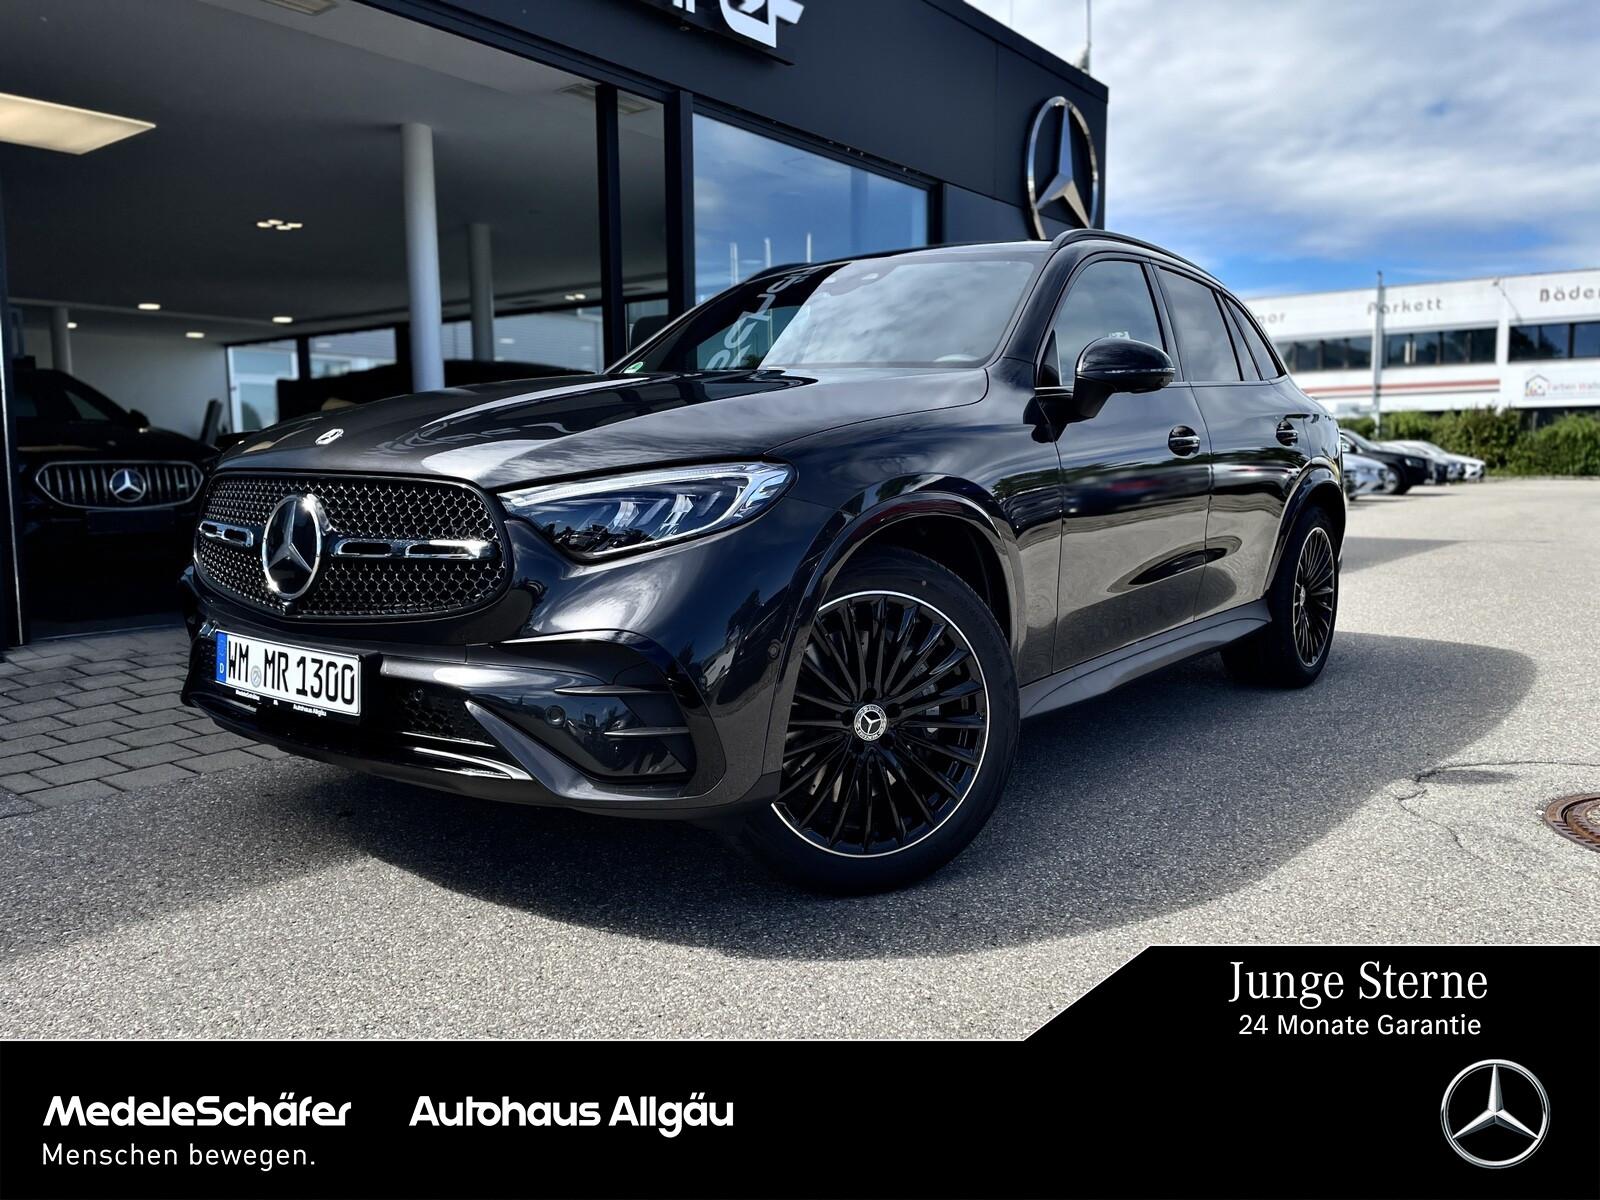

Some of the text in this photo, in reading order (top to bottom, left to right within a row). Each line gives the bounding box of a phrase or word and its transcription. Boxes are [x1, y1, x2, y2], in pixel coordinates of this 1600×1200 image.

[228, 640, 355, 705] WM MR 1300
